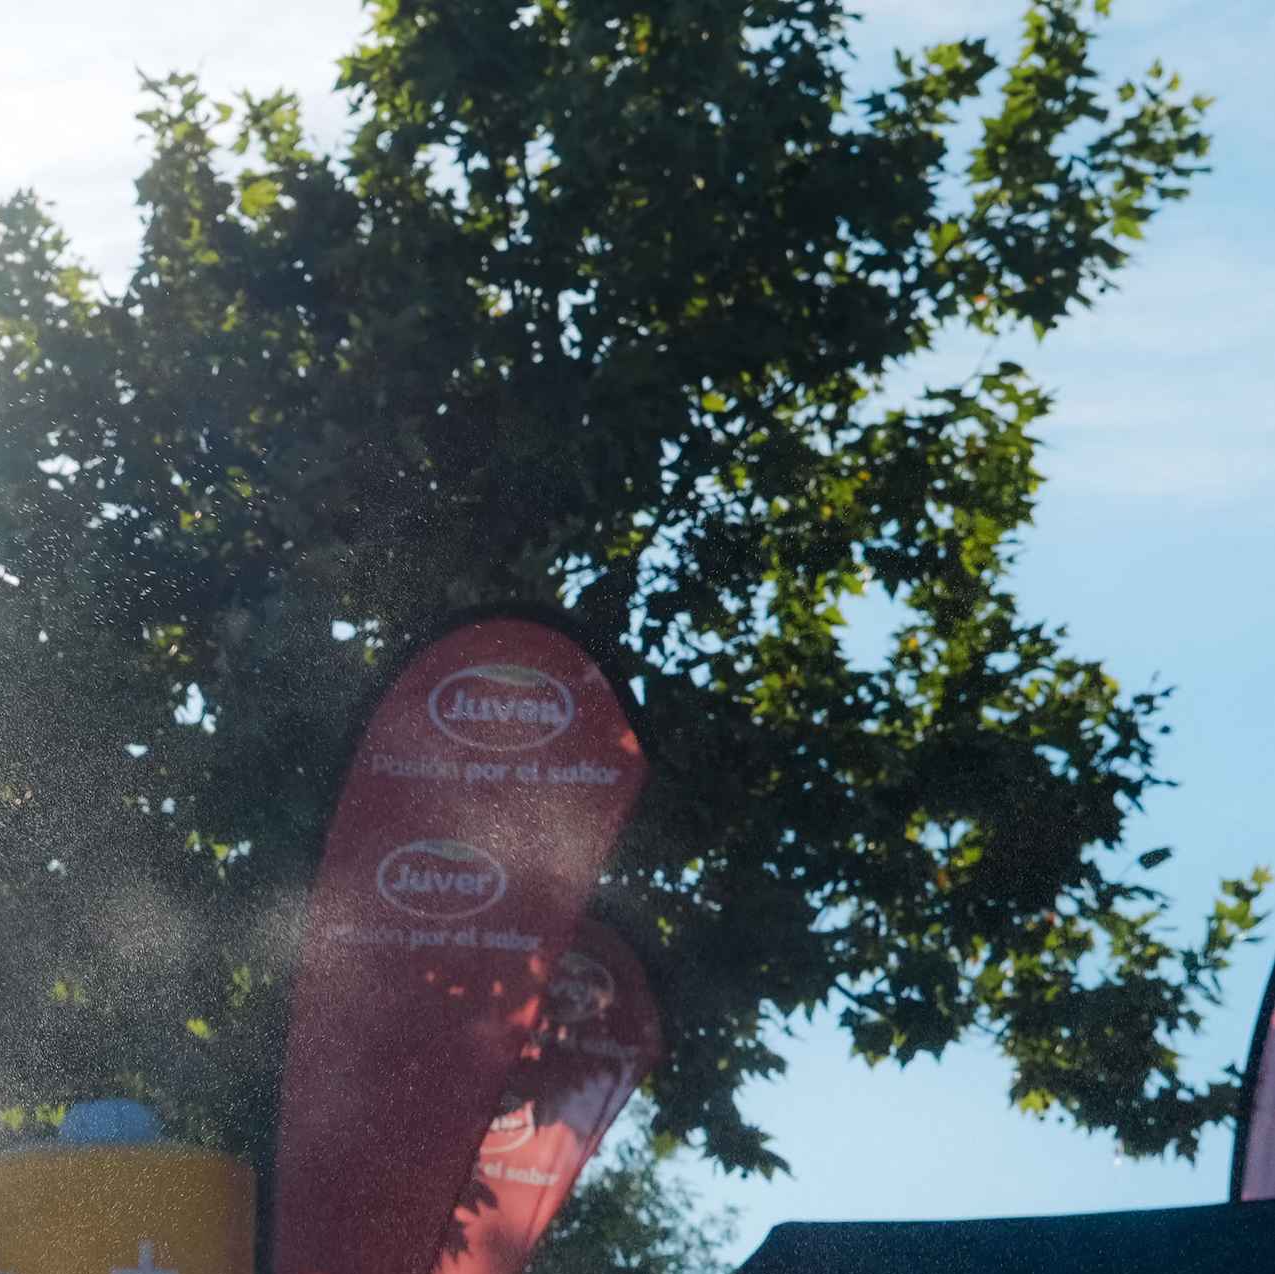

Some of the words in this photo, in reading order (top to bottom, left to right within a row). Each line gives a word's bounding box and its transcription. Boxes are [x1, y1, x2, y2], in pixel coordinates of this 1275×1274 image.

[466, 763, 507, 786] por
[516, 760, 540, 783] el
[548, 760, 622, 786] sabor
[391, 863, 494, 896] Juver
